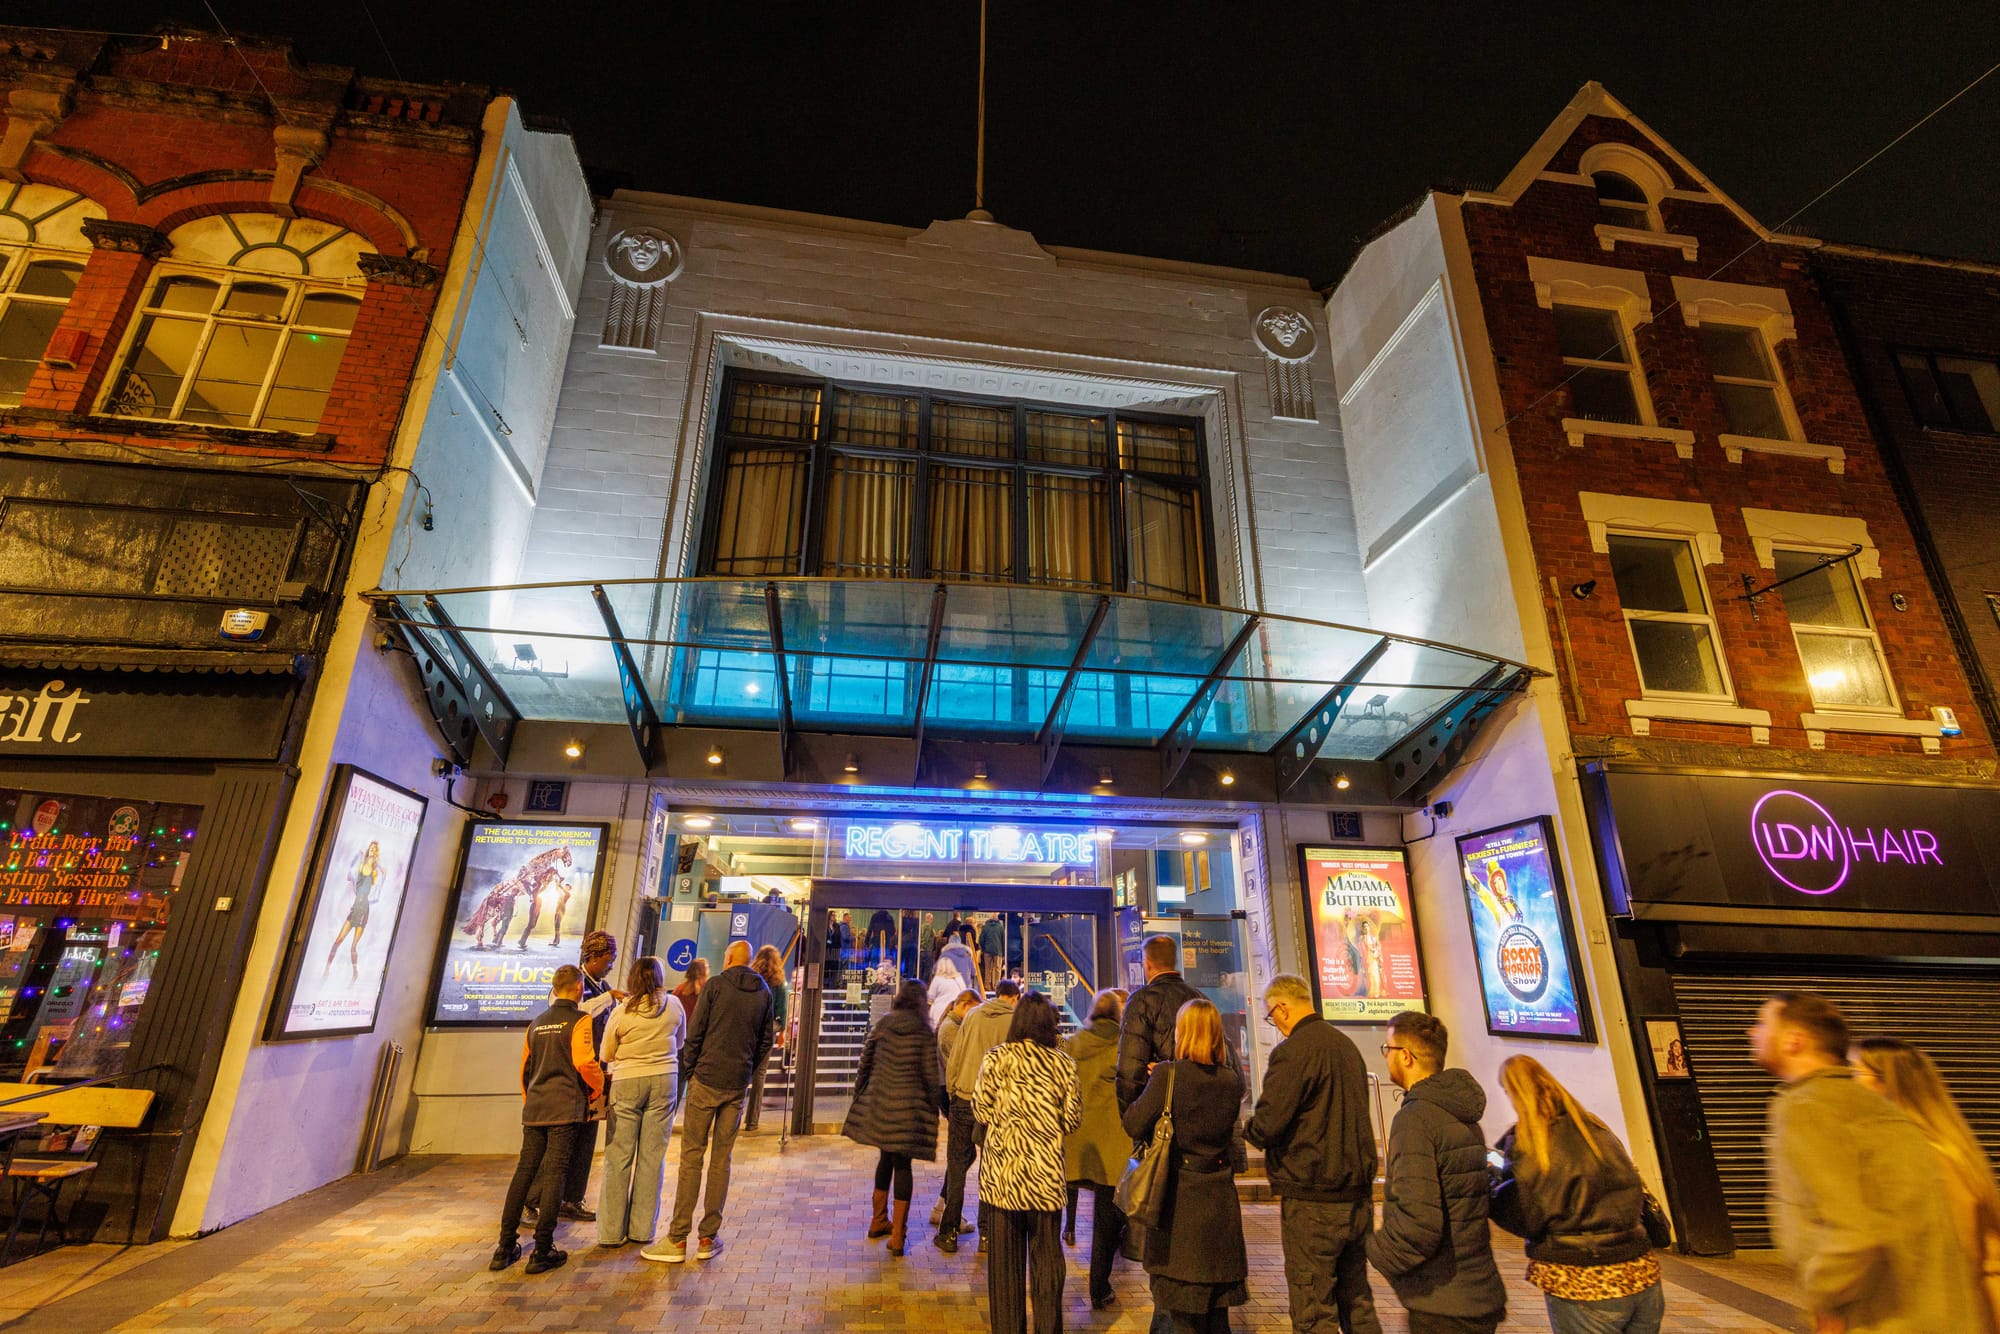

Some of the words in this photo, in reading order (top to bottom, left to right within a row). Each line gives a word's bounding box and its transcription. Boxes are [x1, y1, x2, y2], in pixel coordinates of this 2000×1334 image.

[0, 680, 90, 743] aft
[475, 836, 514, 844] RETURNS
[515, 836, 526, 844] TO
[528, 837, 597, 846] STOKE-ON-TRENT
[483, 828, 501, 836] THE
[502, 828, 533, 837] GLOBAL
[535, 829, 592, 838] PHENOMENON
[10, 833, 59, 849] Craft
[61, 834, 102, 851] Beer
[105, 835, 134, 851] Bar
[846, 825, 963, 859] REGENT
[969, 828, 1094, 863] THEATRE
[1500, 839, 1539, 854] FUNNIEST
[1762, 822, 1835, 861] LDN
[1846, 826, 1944, 865] HAIR
[25, 851, 80, 868] Bottle
[82, 852, 125, 873] Shop
[53, 870, 130, 888] Sessions
[1327, 876, 1392, 891] MADAMA
[5, 888, 73, 905] Private
[1325, 891, 1397, 906] BUTTERFLY
[1502, 946, 1541, 962] ROCKY
[1504, 963, 1542, 980] HORROR
